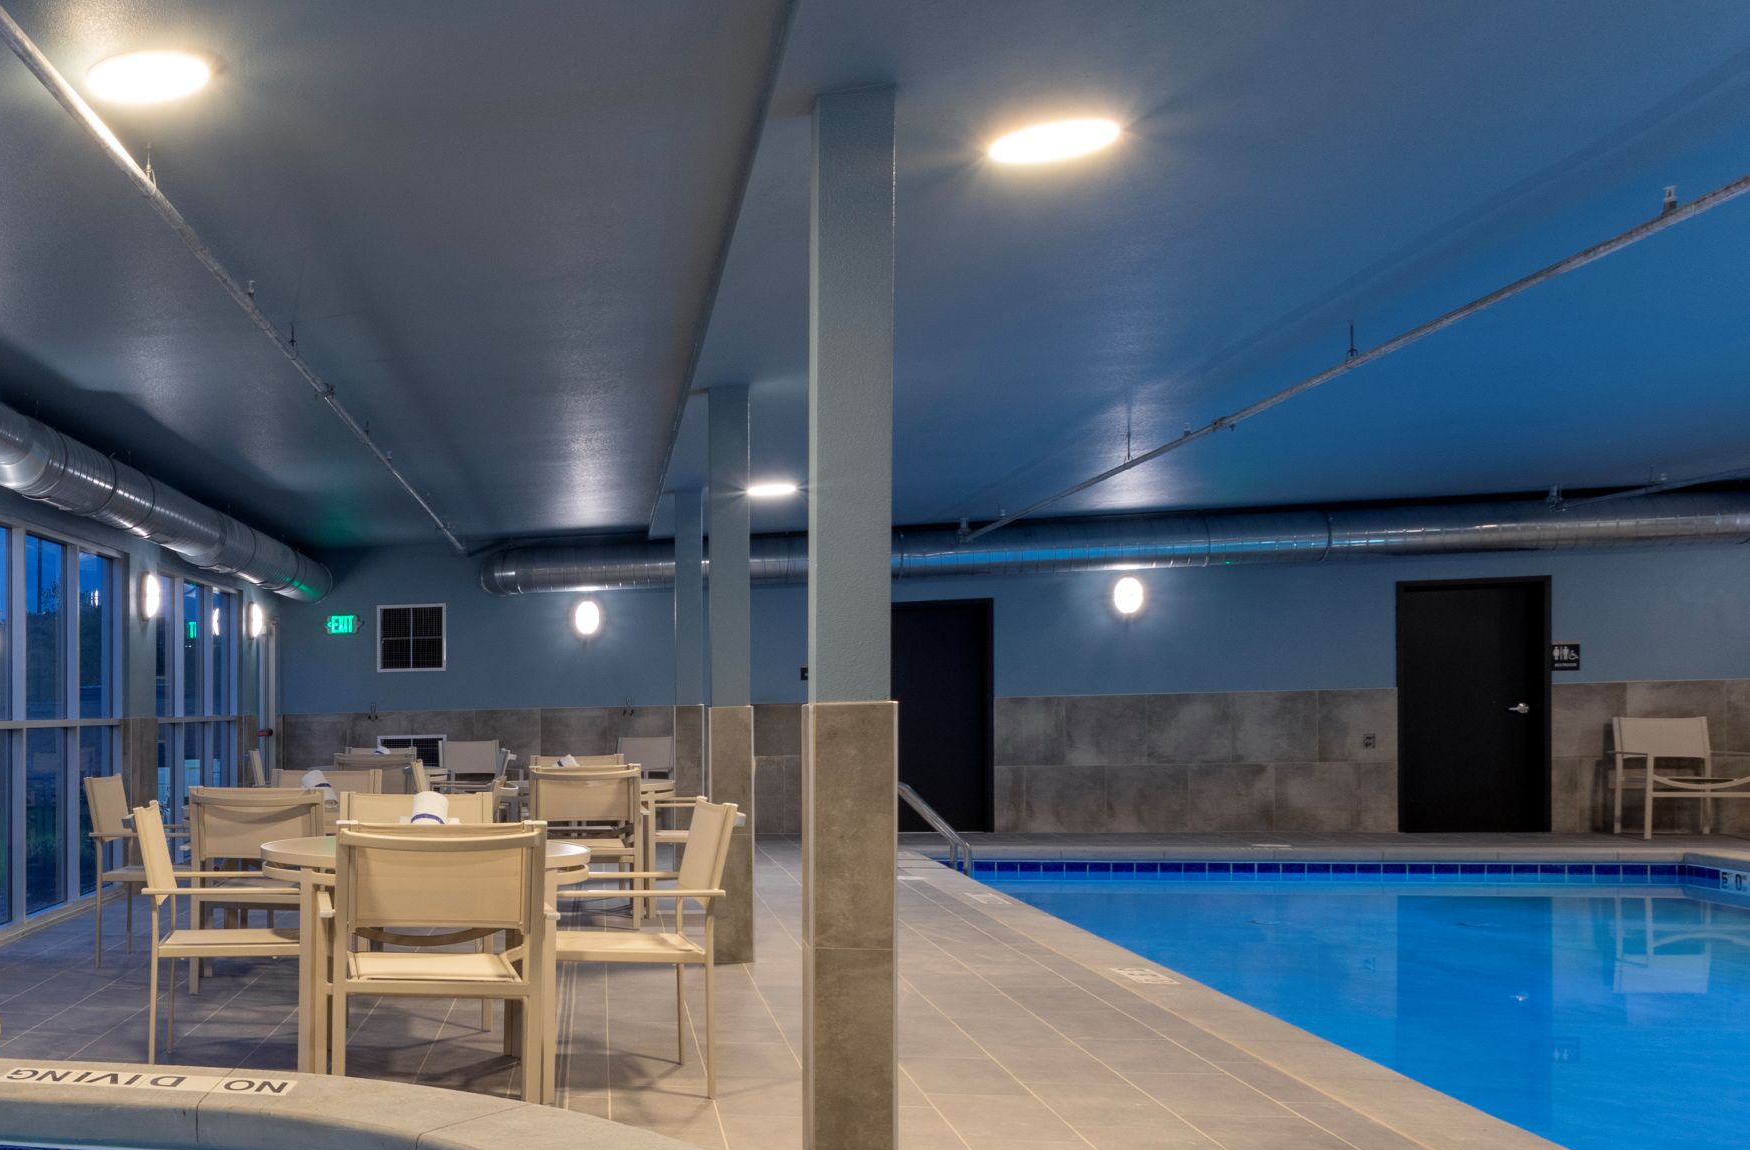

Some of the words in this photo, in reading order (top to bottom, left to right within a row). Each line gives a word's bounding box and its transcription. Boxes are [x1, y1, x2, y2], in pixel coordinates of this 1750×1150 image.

[332, 615, 354, 633] EXIT
[6, 1069, 186, 1088] DIVING
[223, 1079, 288, 1093] NO
